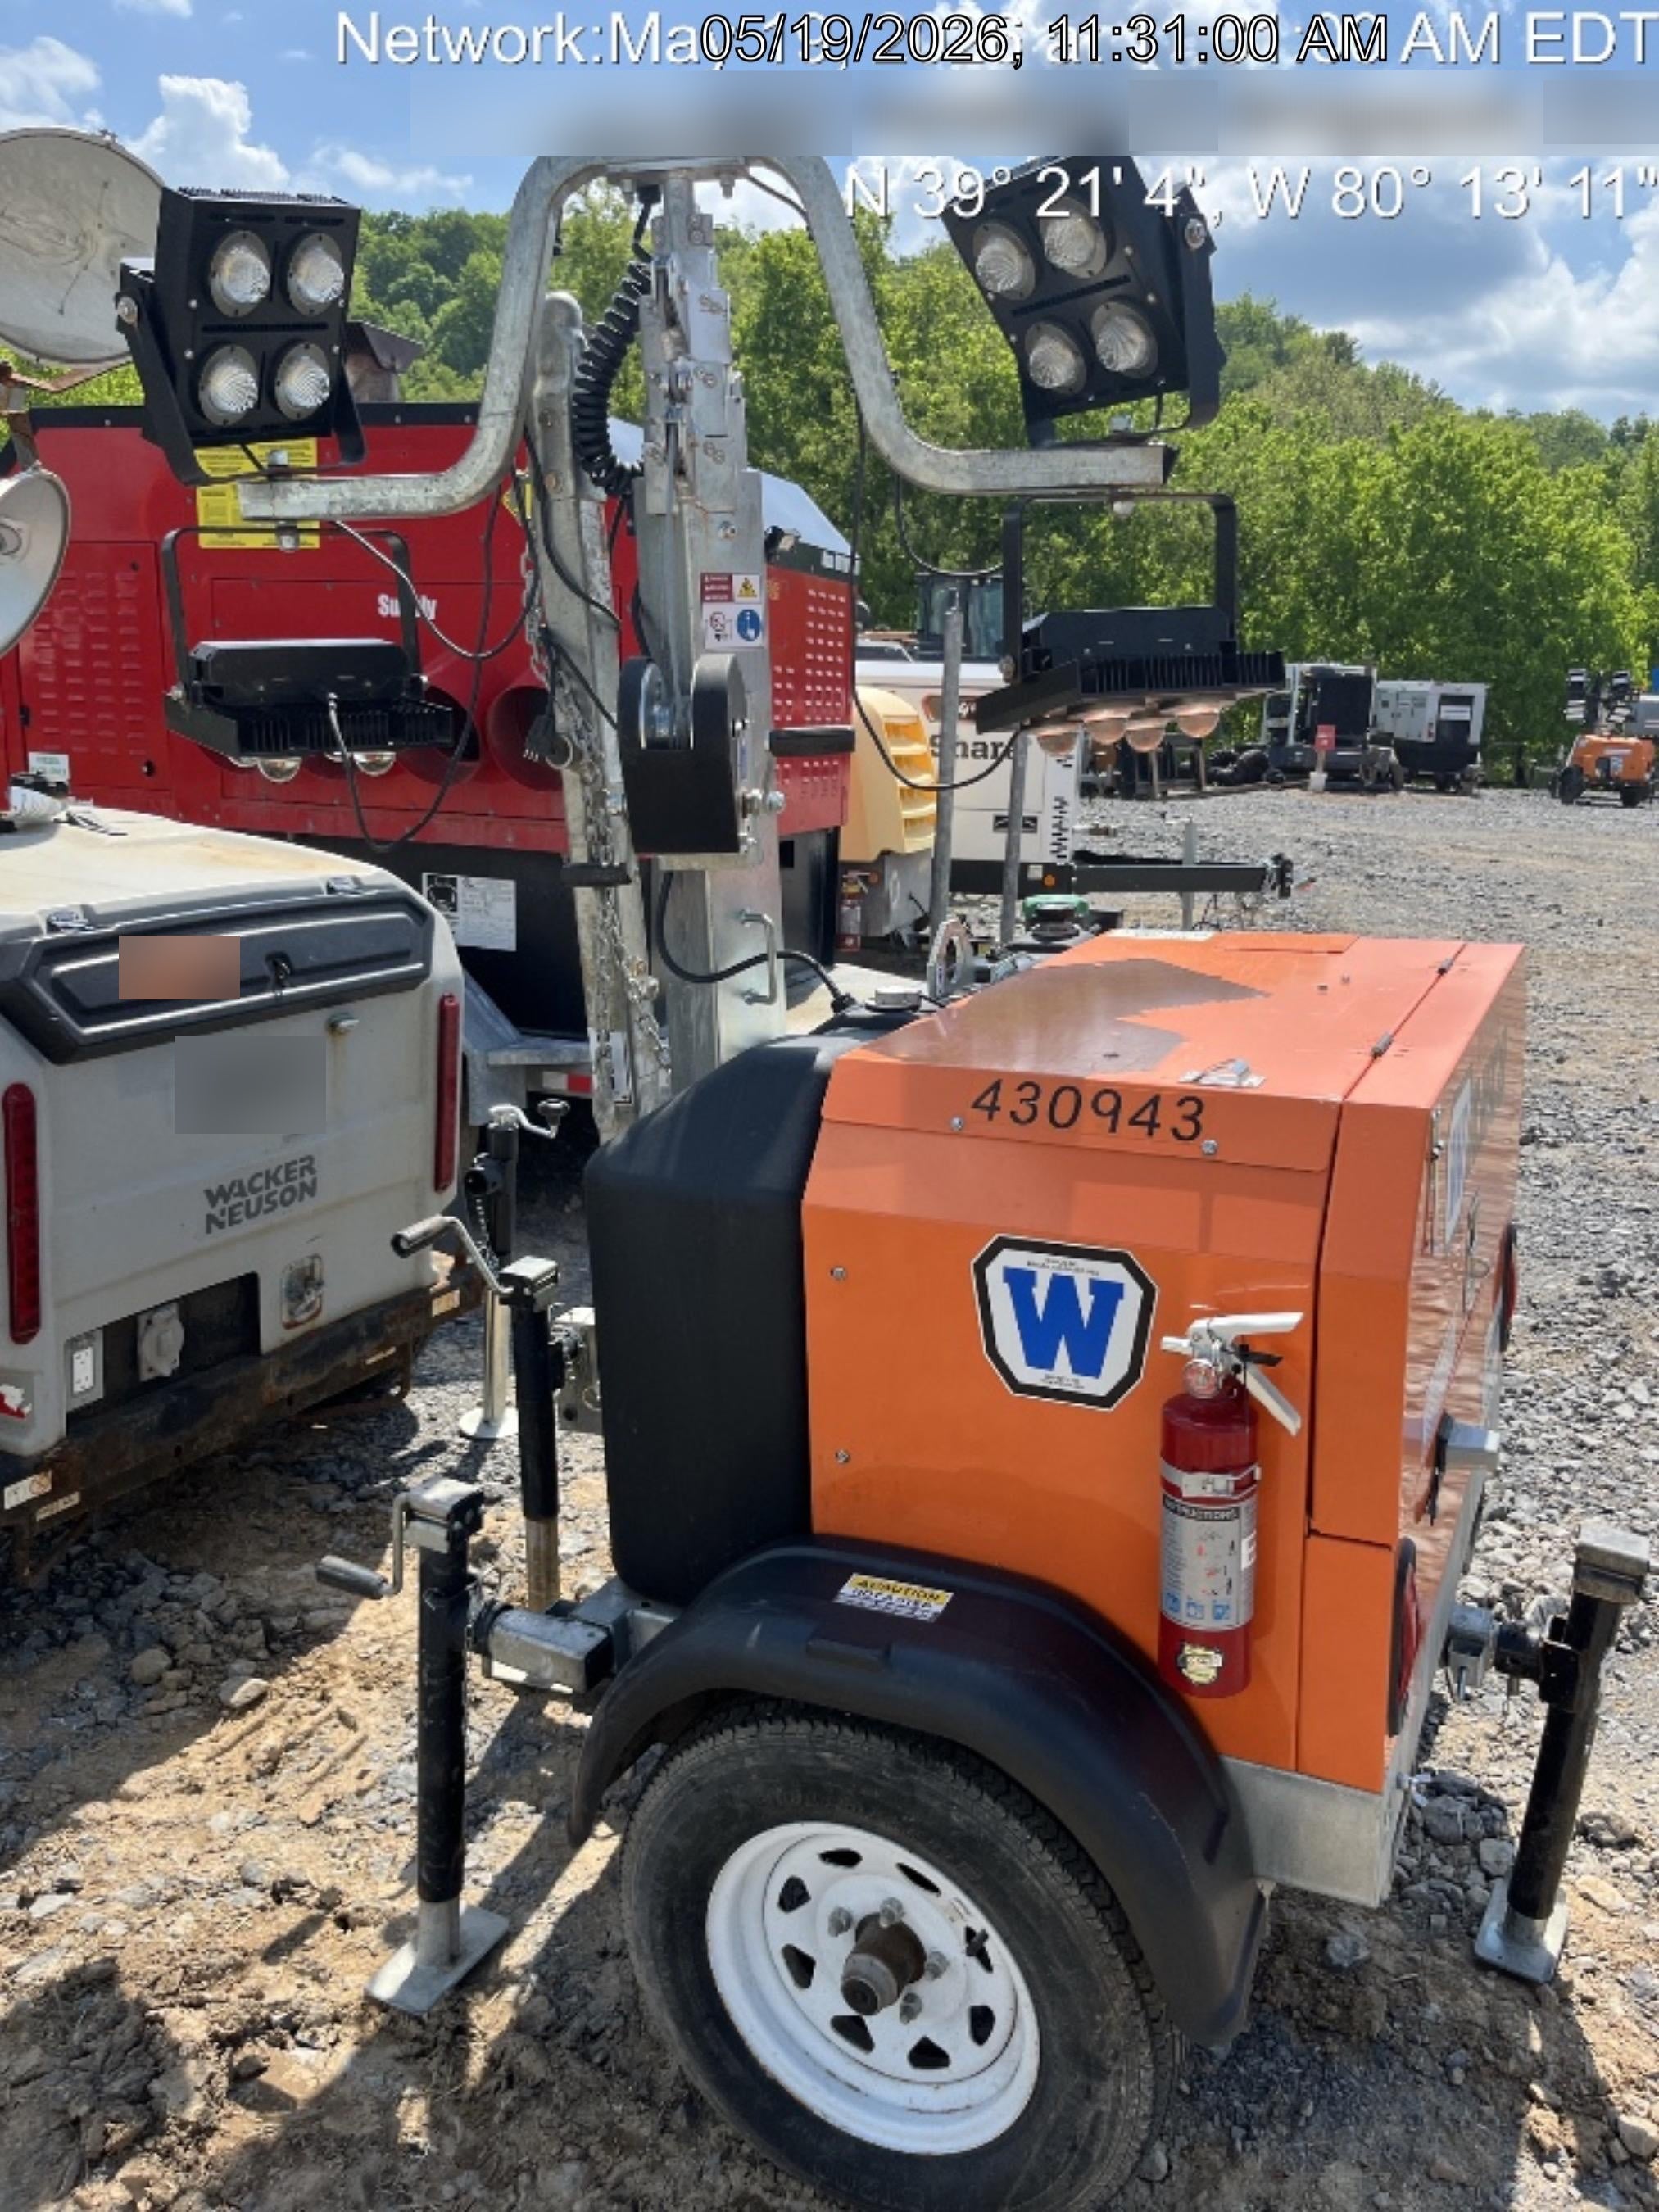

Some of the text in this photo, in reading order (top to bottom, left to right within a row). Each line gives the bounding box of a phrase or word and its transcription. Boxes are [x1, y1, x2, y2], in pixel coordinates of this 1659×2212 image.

[378, 594, 437, 620] Suly
[970, 1078, 1205, 1141] 430943
[203, 1154, 317, 1209] WACKER
[205, 1176, 318, 1235] NEUSON
[1002, 1265, 1125, 1379] W
